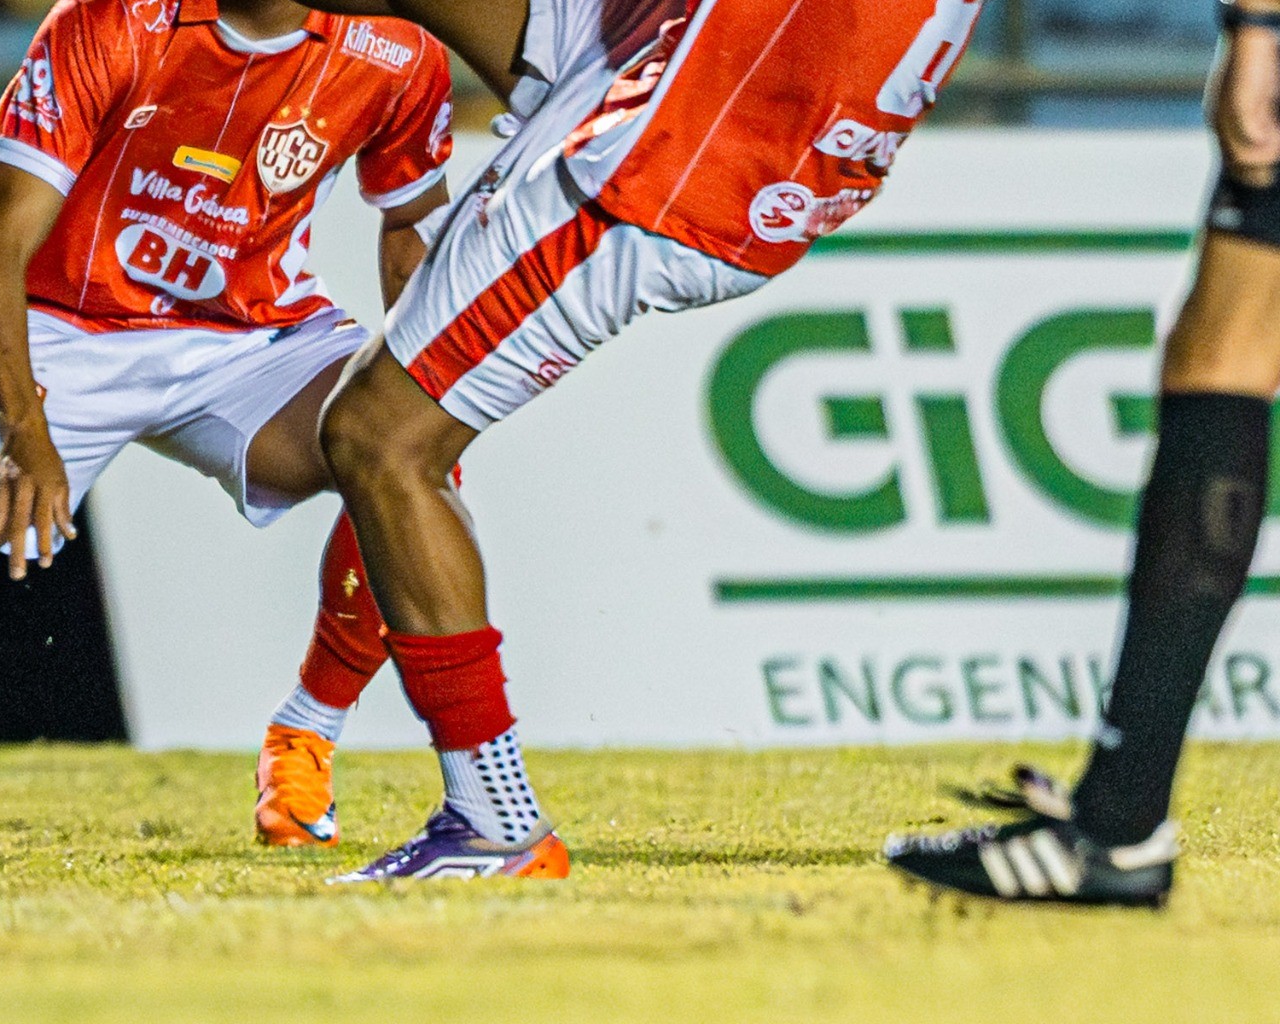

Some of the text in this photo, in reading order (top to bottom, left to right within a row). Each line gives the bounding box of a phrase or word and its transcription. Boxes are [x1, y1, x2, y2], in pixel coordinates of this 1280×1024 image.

[262, 129, 318, 179] USC
[130, 167, 182, 201] Villa
[121, 207, 237, 260] SUPERMERCADOS
[127, 229, 212, 292] BH
